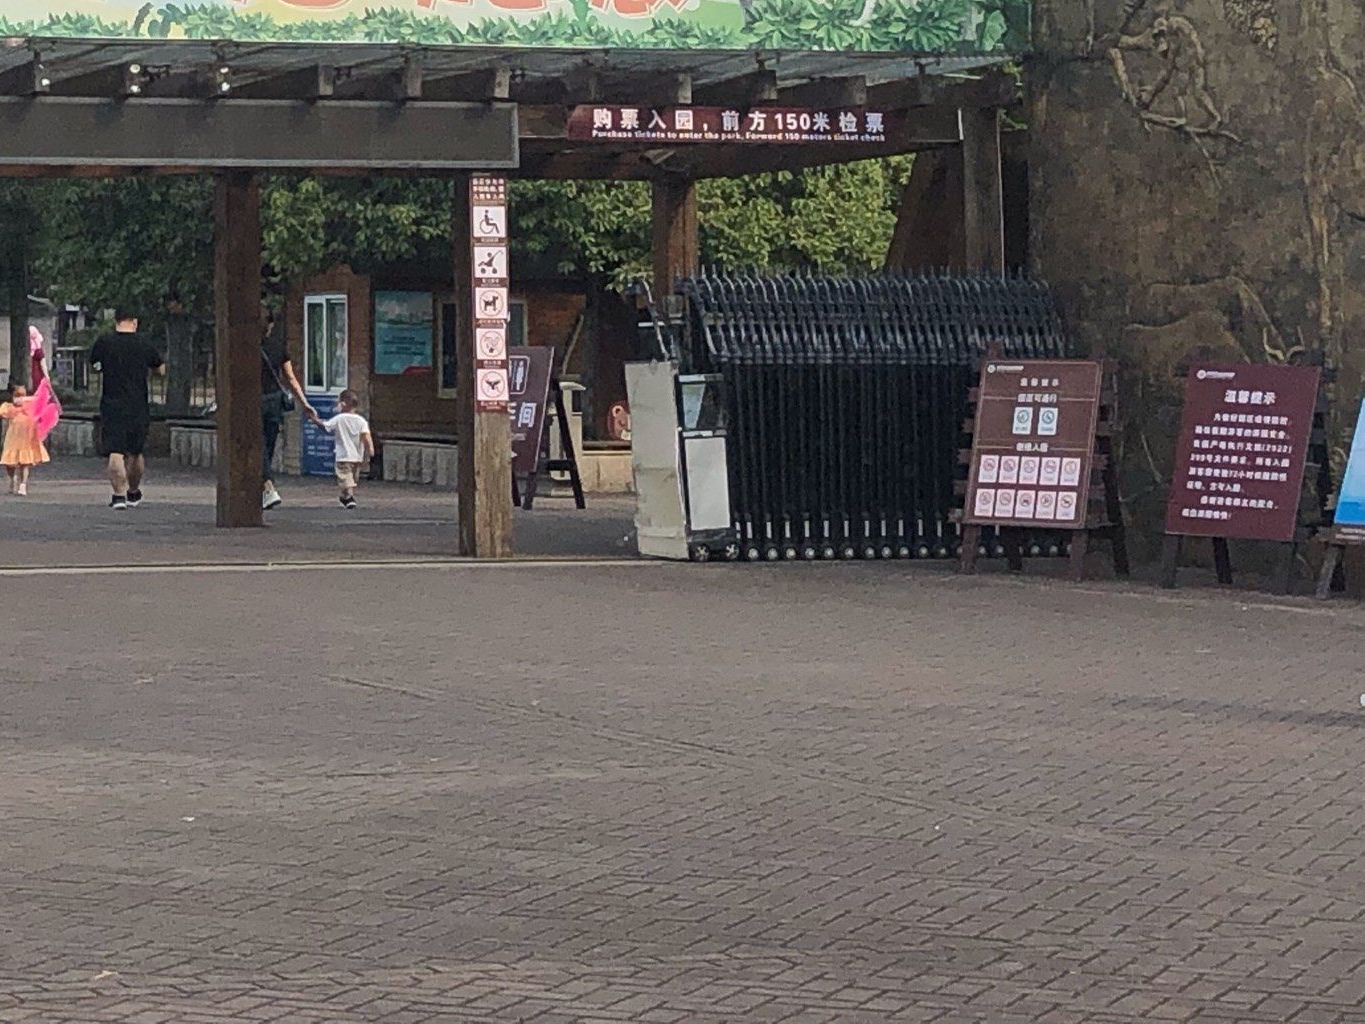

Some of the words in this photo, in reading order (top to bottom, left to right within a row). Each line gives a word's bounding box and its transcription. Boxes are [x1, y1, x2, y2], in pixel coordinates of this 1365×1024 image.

[592, 108, 884, 132] 购票入园，前方150米检票
[592, 129, 633, 138] Purchase
[634, 130, 666, 138] tickets
[668, 131, 677, 139] to
